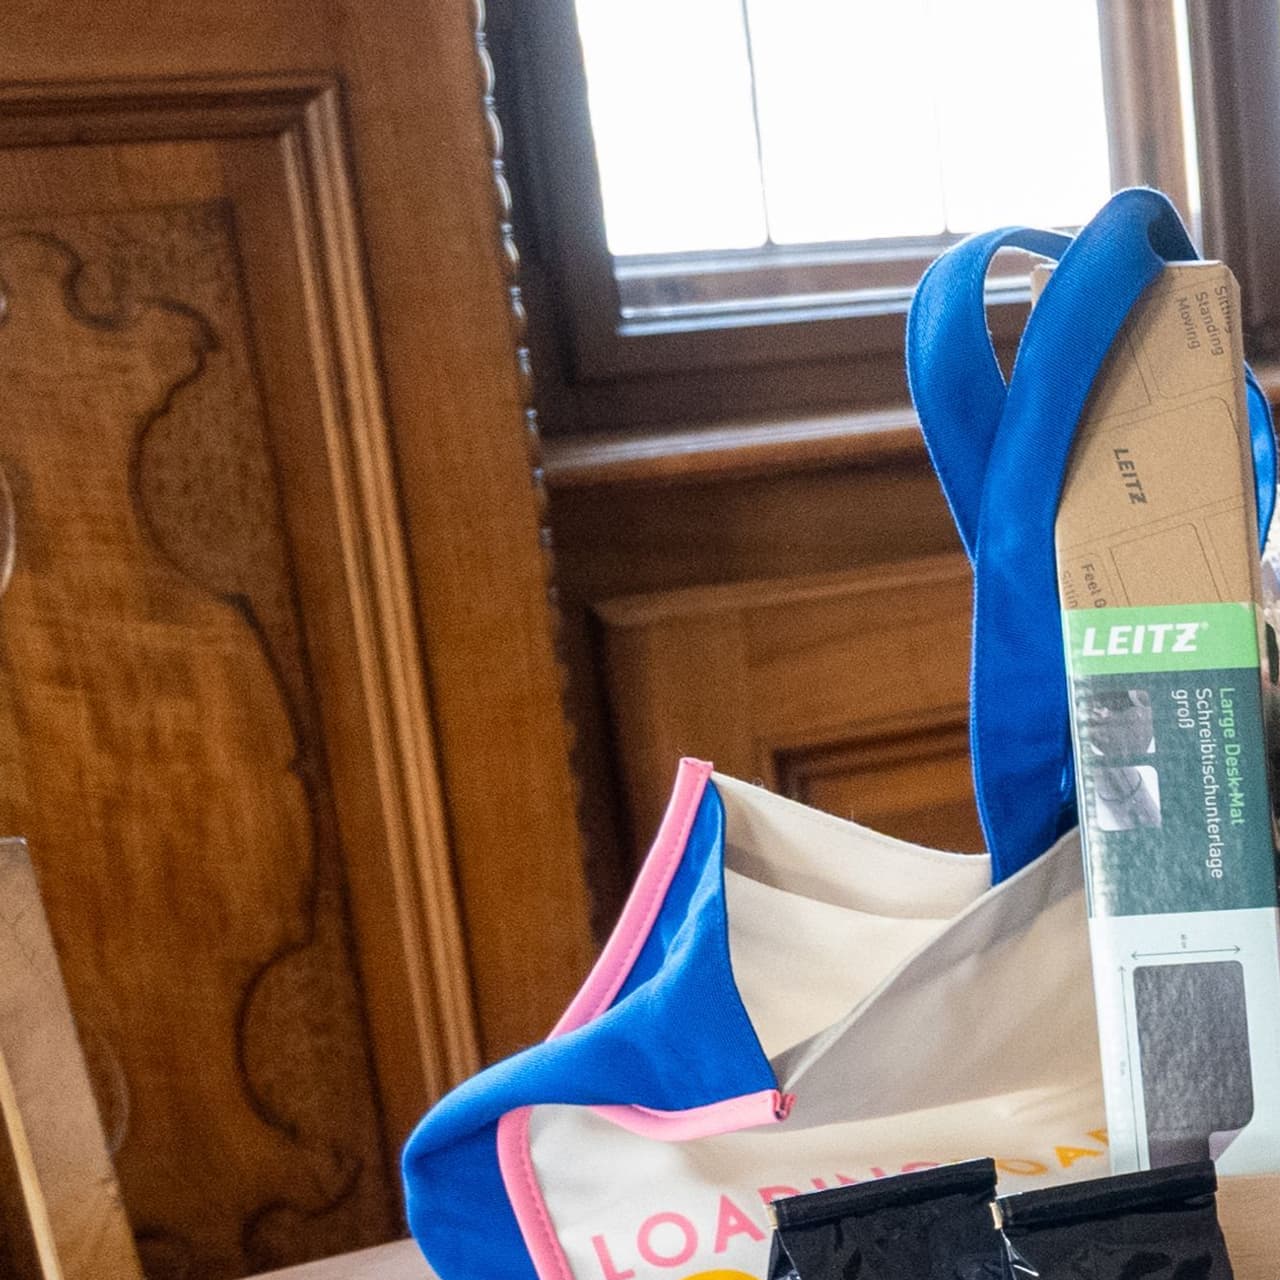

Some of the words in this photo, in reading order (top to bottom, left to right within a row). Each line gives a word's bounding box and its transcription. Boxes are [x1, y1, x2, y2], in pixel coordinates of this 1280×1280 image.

[1177, 296, 1201, 350] Moving
[1195, 291, 1225, 356] Standing
[1113, 447, 1148, 506] LEITZ
[1082, 622, 1200, 658] LEITZ
[1171, 689, 1195, 729] groß
[1218, 687, 1237, 738] Large
[1195, 687, 1225, 880] Schreibtischunterlage
[1225, 743, 1246, 826] Desk-Mat
